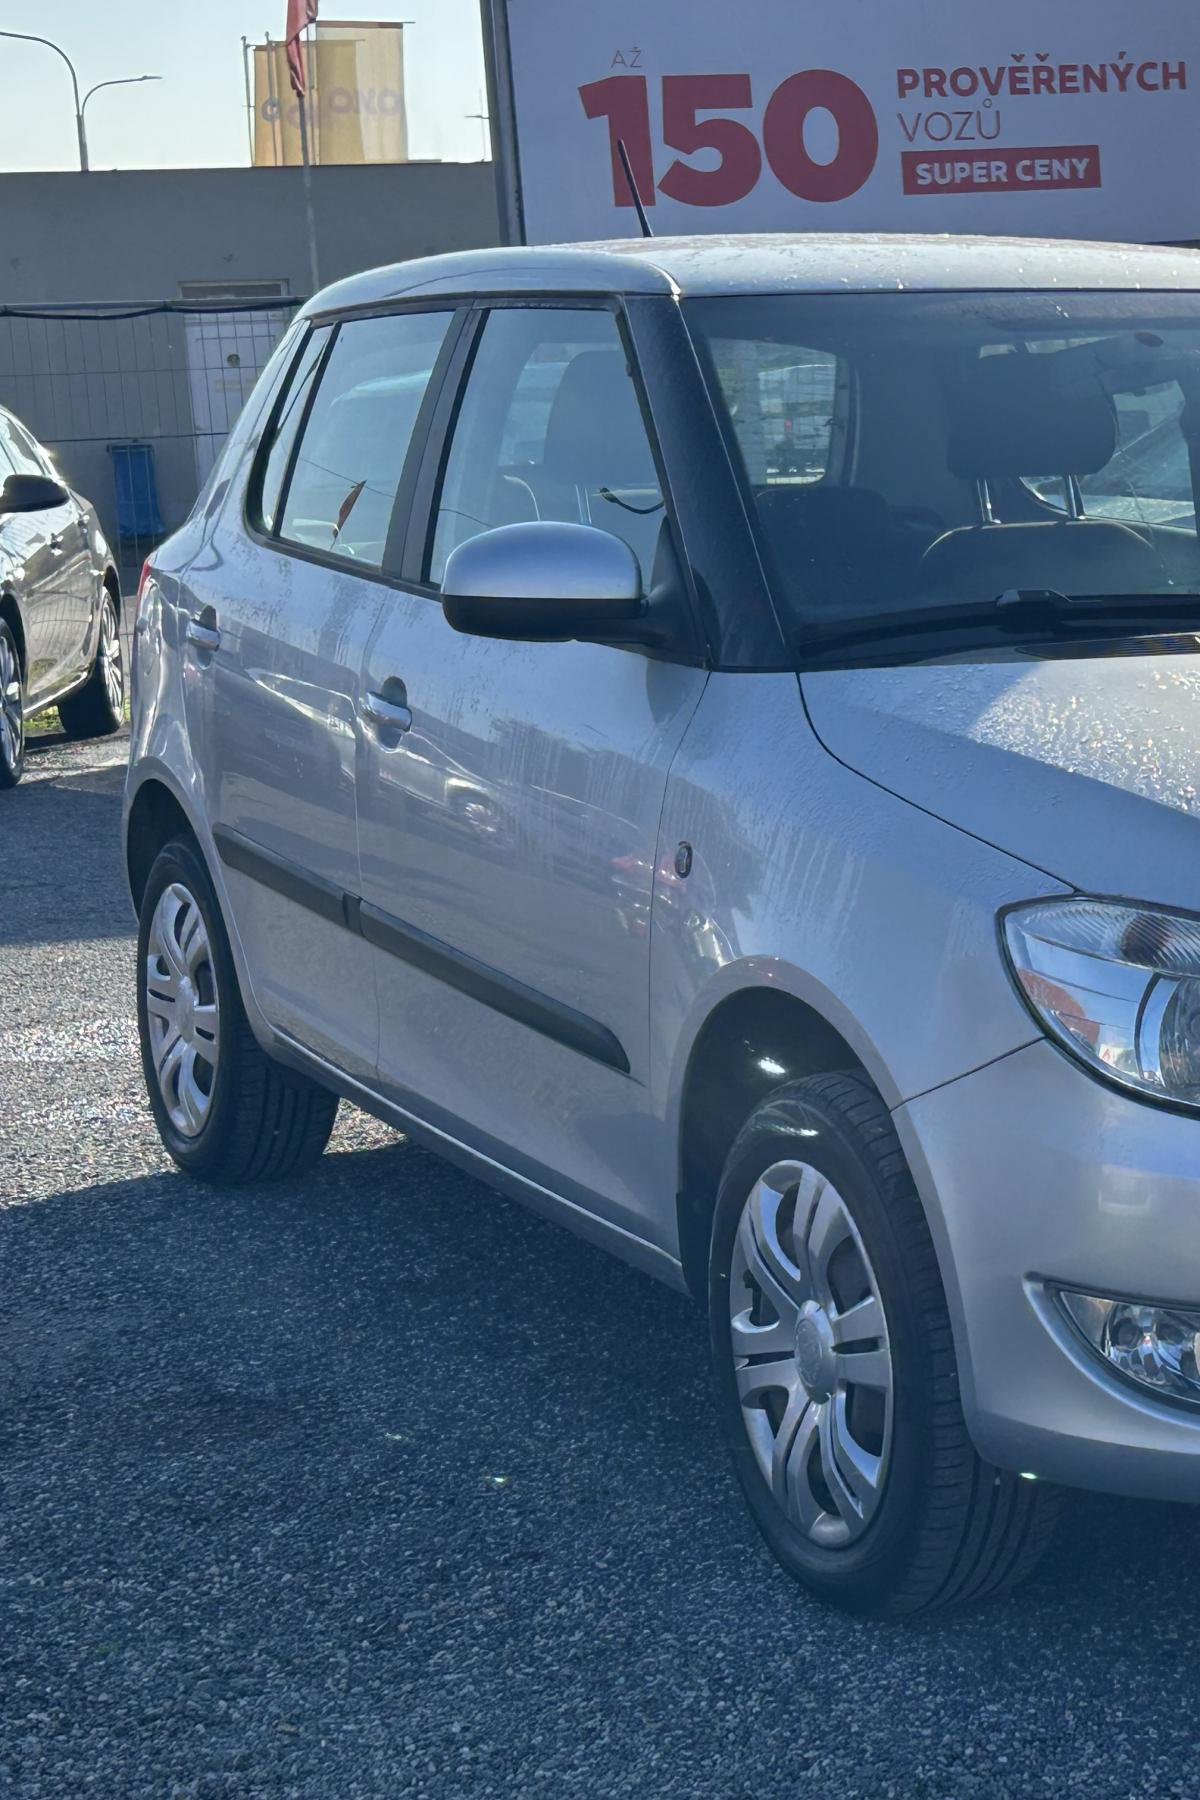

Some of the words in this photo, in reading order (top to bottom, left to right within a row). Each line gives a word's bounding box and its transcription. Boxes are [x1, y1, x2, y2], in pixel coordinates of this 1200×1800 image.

[610, 46, 643, 69] AŽ
[896, 51, 1187, 99] PROVĚŘENÝCH
[578, 68, 879, 208] 150
[896, 98, 1001, 143] VOZŮ
[914, 160, 1009, 186] SUPER
[1015, 157, 1091, 182] CENY
